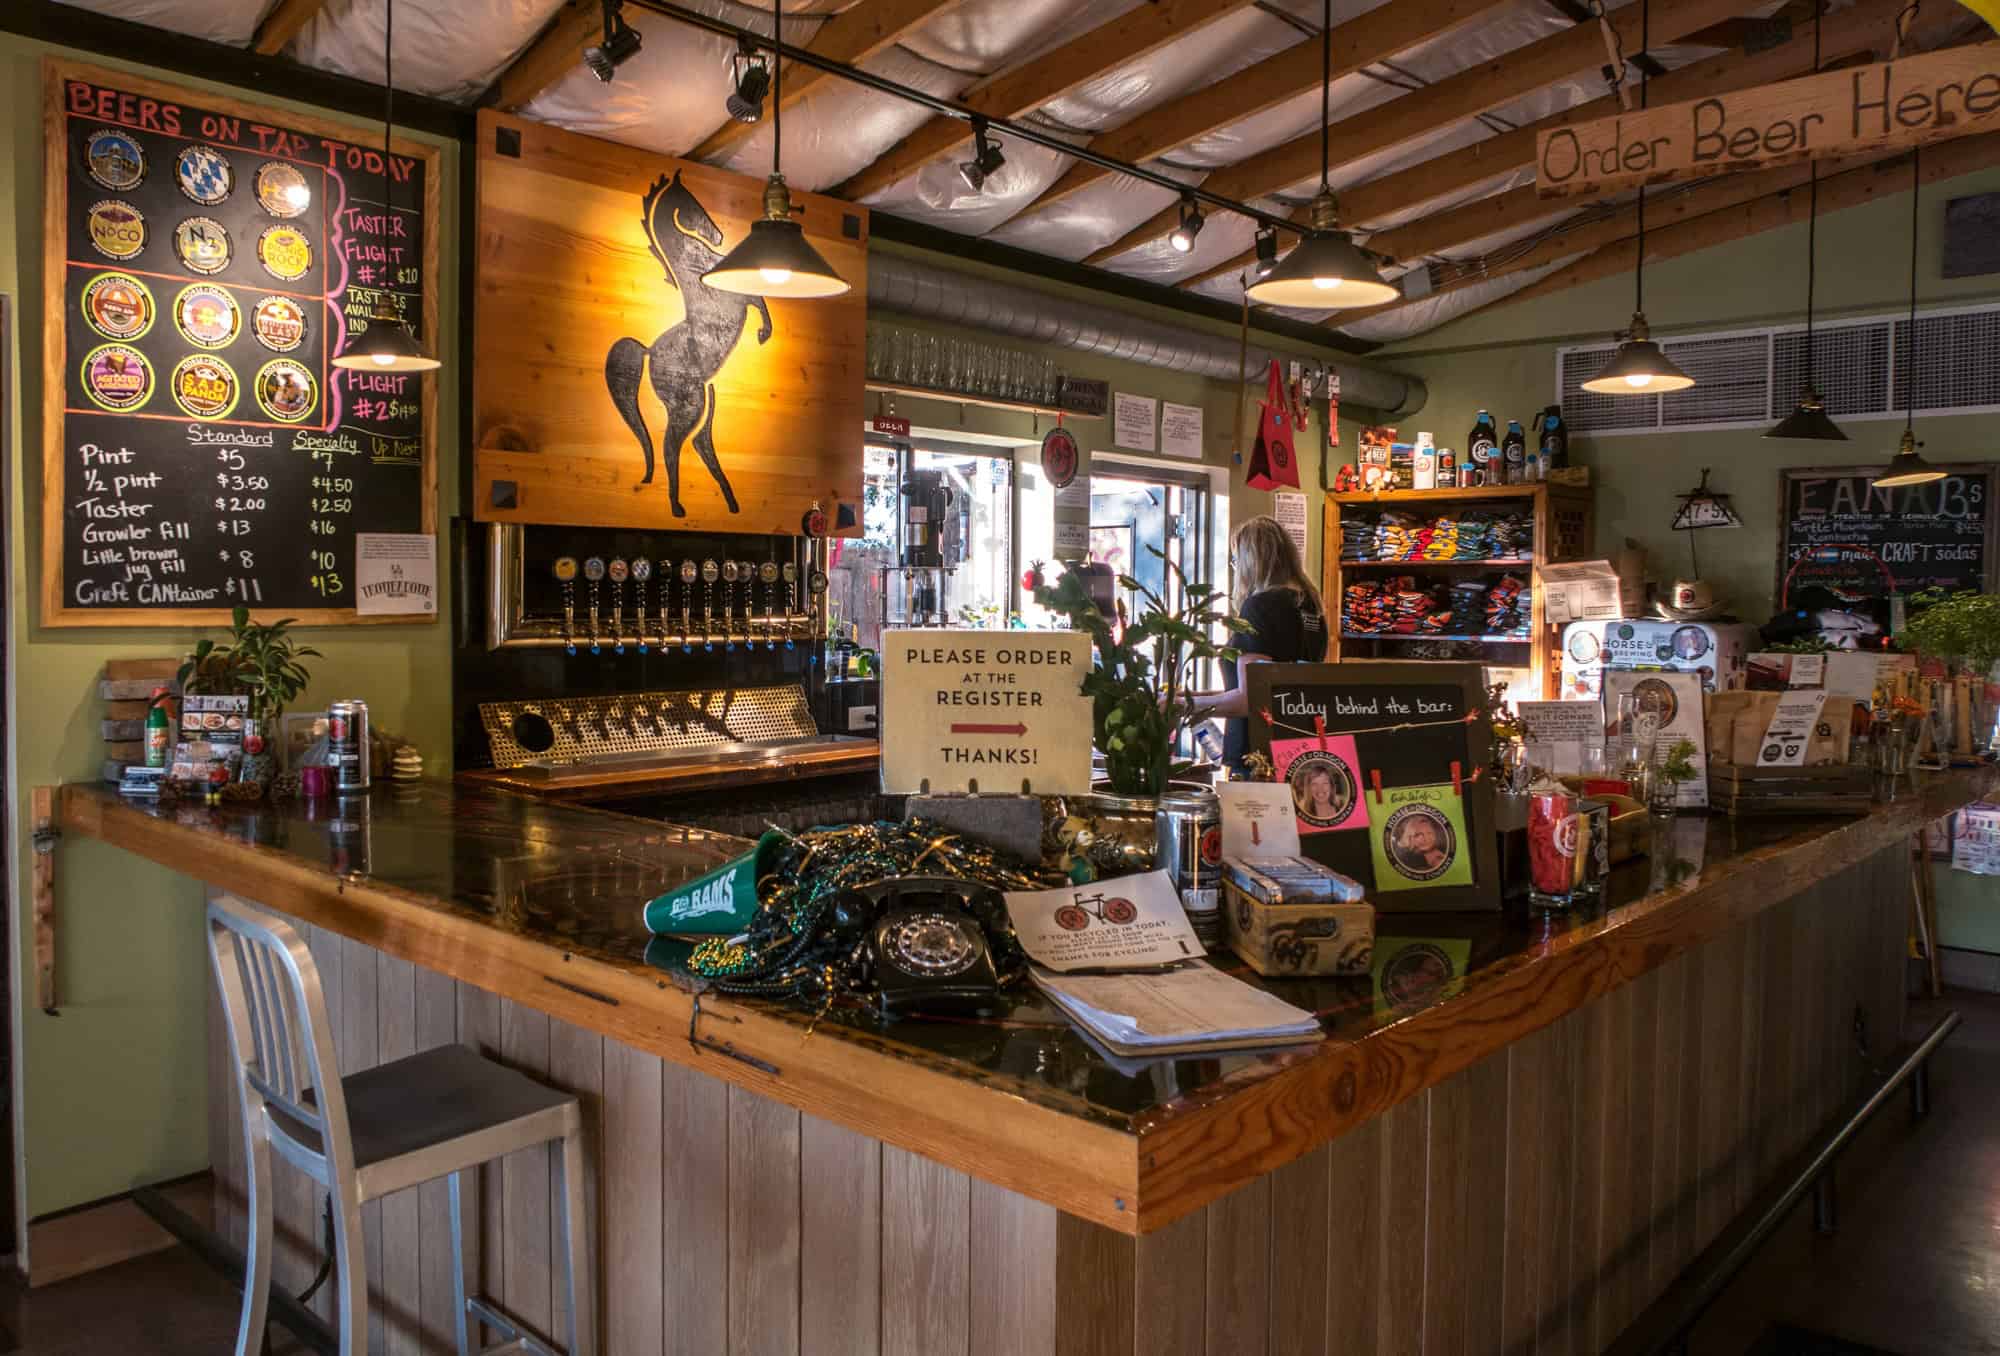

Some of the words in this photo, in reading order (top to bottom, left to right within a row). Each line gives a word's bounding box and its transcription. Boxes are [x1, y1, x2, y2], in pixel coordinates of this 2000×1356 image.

[67, 83, 181, 135] BEERS
[200, 116, 240, 143] ON
[250, 127, 310, 157] TAP
[320, 140, 415, 182] TODAY
[1543, 121, 1671, 183] Order
[1692, 100, 1824, 162] Beer
[1852, 65, 2000, 137] Here
[344, 208, 406, 237] TASTER
[344, 238, 404, 263] FLIGHT
[398, 268, 418, 284] $10
[353, 398, 388, 420] #2
[187, 424, 274, 445] Standard
[293, 430, 359, 452] Specialty
[80, 444, 135, 466] Pint
[218, 449, 245, 471] $5
[114, 473, 161, 496] pint
[312, 477, 353, 493] $4.50
[76, 497, 153, 520] Taster
[312, 497, 352, 513] $2.50
[83, 523, 152, 544] Growler
[160, 520, 190, 540] fill
[130, 547, 178, 563] brown
[311, 550, 335, 571] $10
[1882, 543, 1932, 563] CRAFT
[1936, 546, 1977, 561] sodas
[126, 563, 150, 583] jug
[161, 559, 186, 574] fill
[76, 579, 130, 605] Craft
[907, 649, 985, 664] PLEASE
[996, 650, 1072, 665] ORDER
[963, 673, 981, 684] AT
[988, 673, 1016, 684] THE
[937, 691, 1043, 706] REGISTER
[1273, 691, 1327, 726] Today
[1336, 695, 1379, 715] behind
[1385, 697, 1411, 714] the
[1418, 694, 1454, 714] bar:
[941, 748, 1039, 764] THANKS!
[691, 869, 737, 912] RAMS
